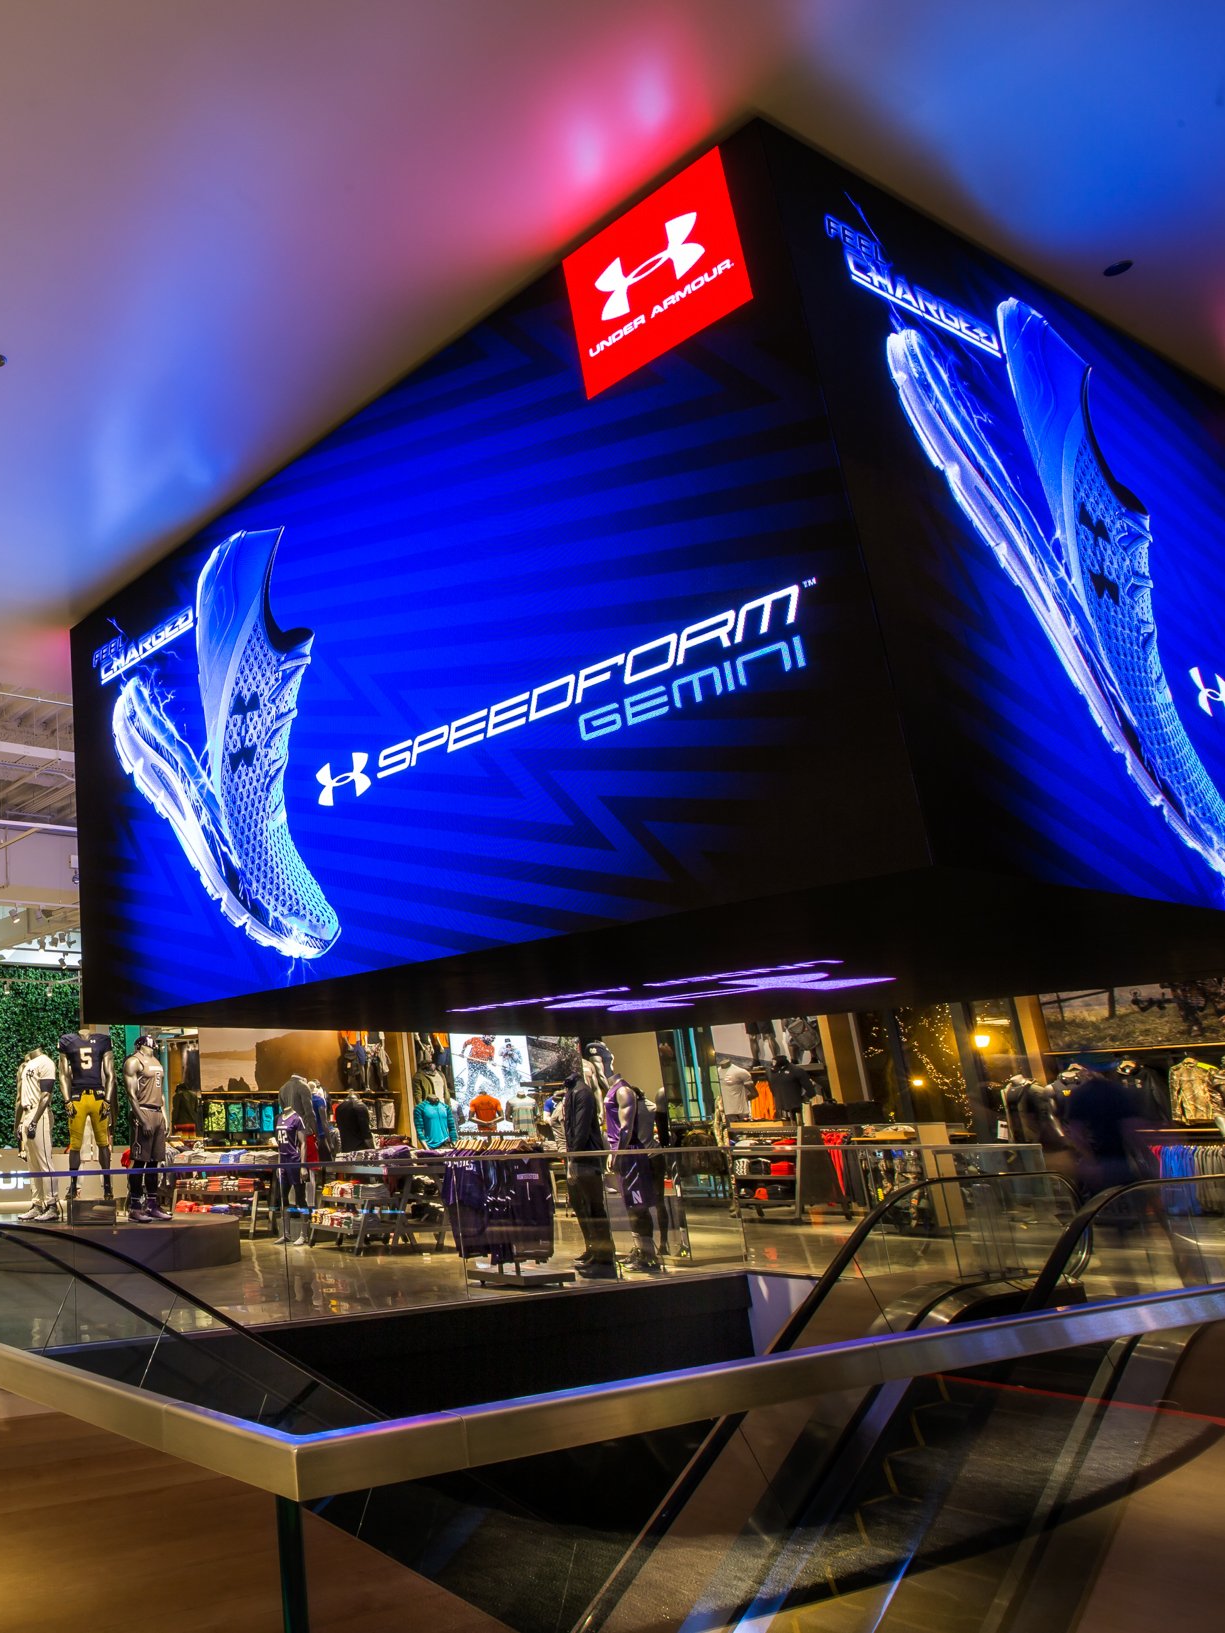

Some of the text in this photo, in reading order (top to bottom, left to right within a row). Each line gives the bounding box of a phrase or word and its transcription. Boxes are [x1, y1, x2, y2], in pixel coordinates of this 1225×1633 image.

[825, 214, 888, 266] FEEL
[845, 249, 1000, 352] CHARGED
[588, 313, 646, 358] UNDER
[92, 635, 125, 669] FEEL
[100, 605, 194, 681] CHARGED
[376, 583, 800, 779] SPEEDFORM
[578, 634, 807, 742] GEMINI
[79, 1047, 93, 1070] 5
[277, 1129, 289, 1144] 42
[631, 1189, 643, 1205] N
